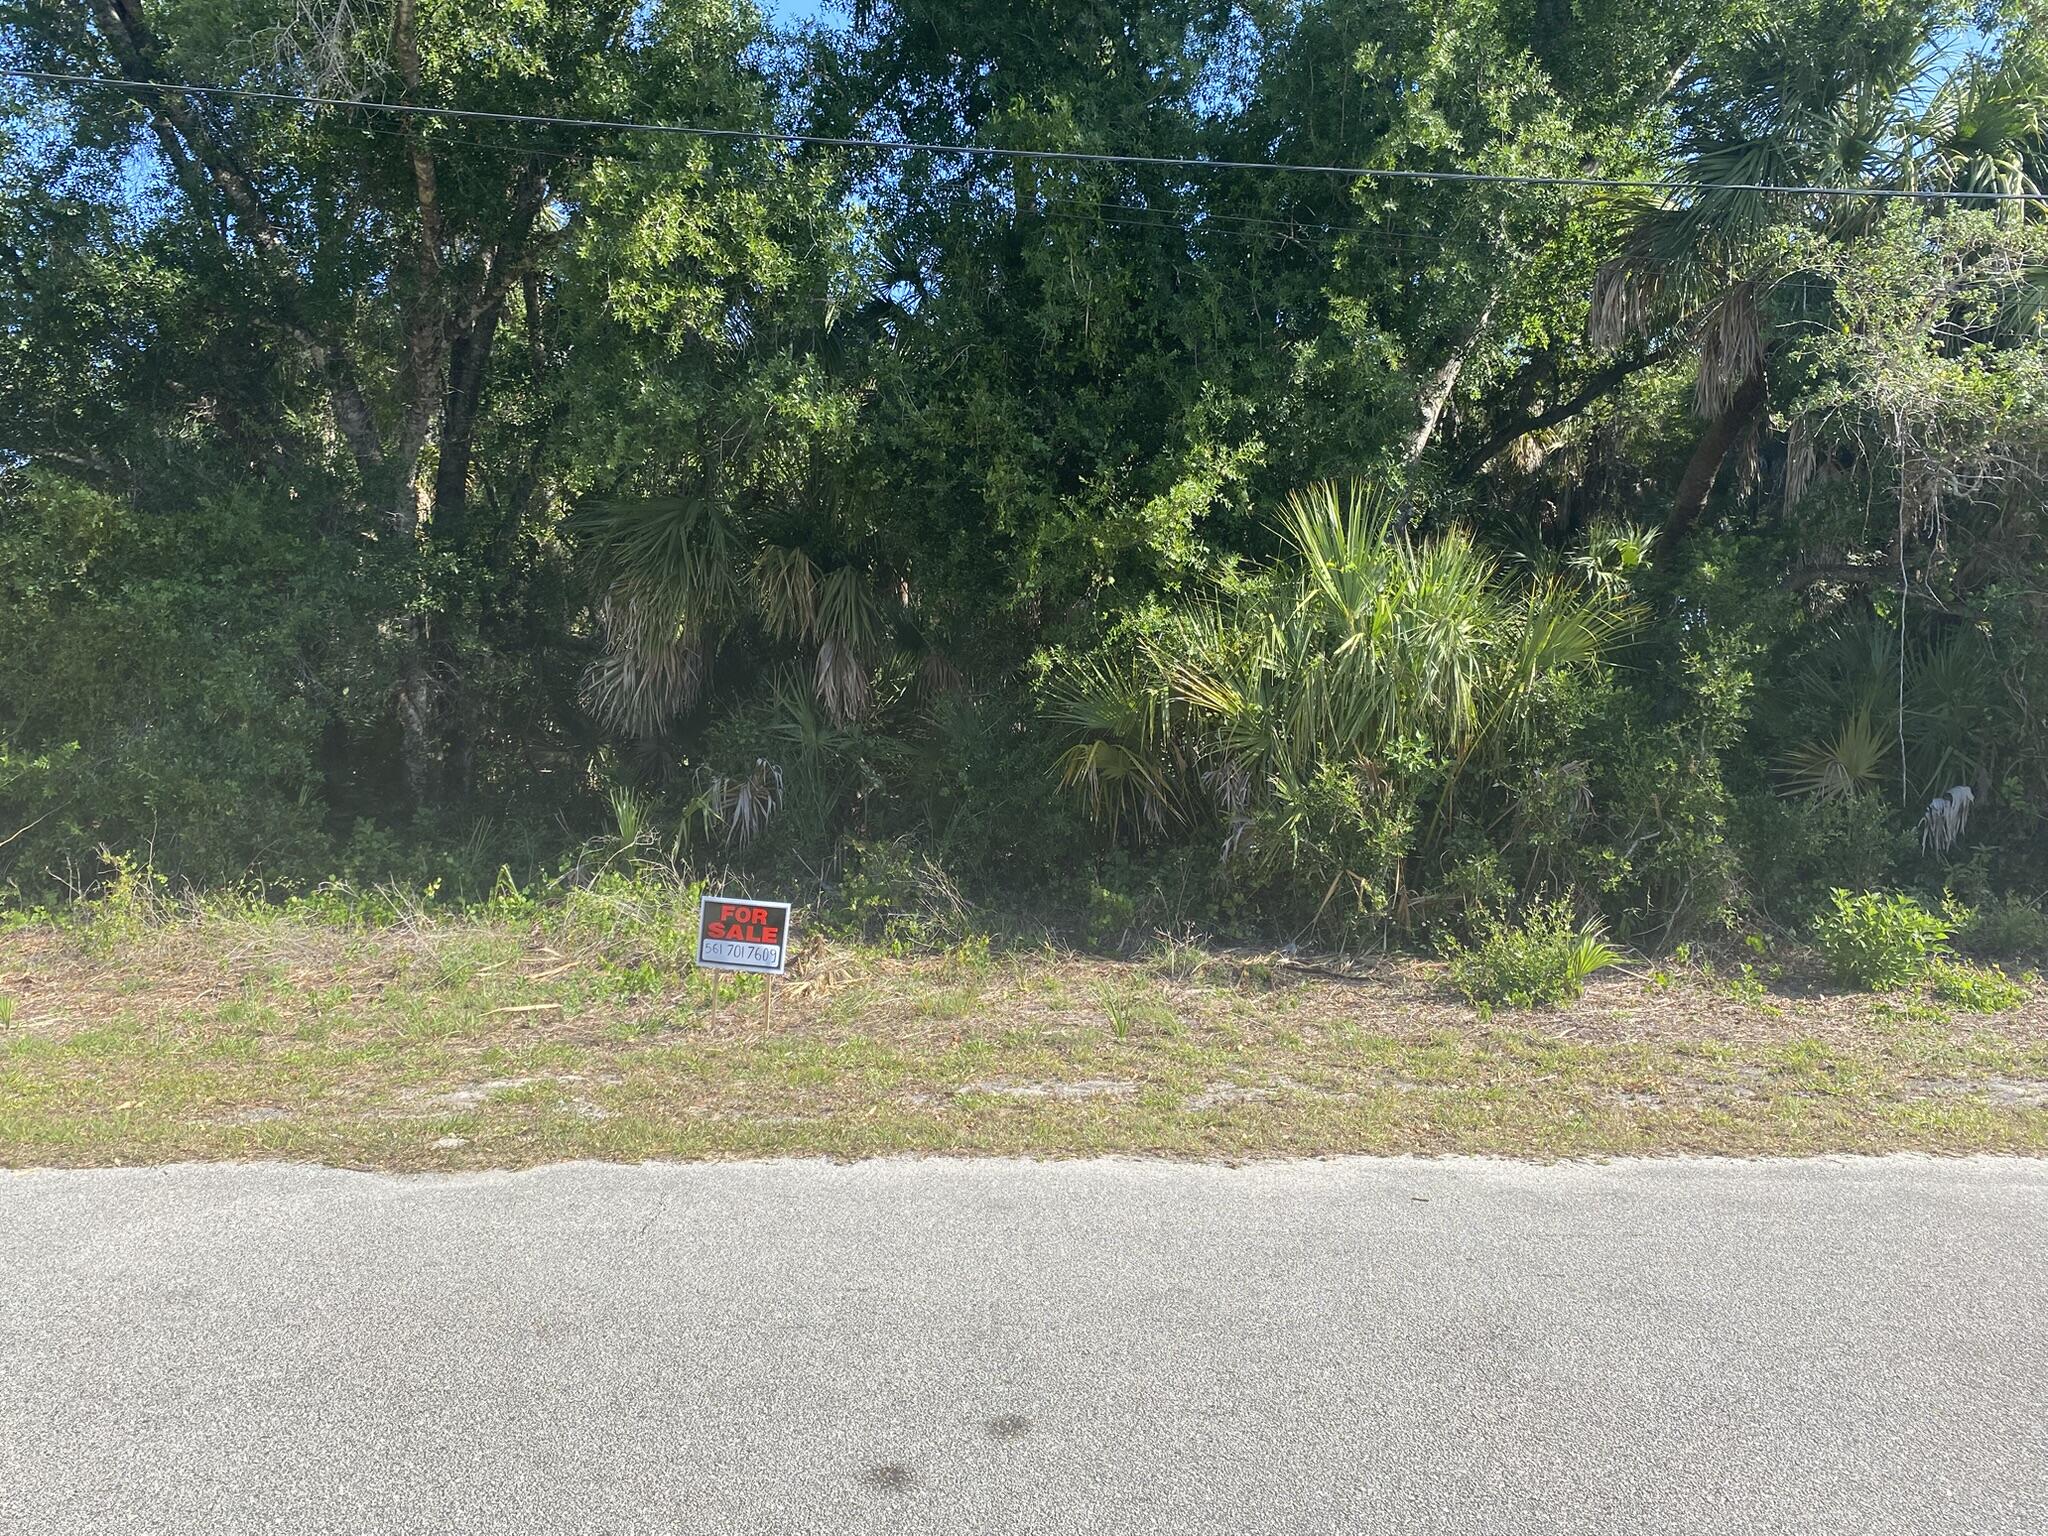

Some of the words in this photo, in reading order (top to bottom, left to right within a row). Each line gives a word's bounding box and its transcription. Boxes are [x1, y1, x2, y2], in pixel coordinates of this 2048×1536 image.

[721, 904, 768, 925] FOR
[707, 922, 778, 944] SALE
[705, 943, 722, 954] 561
